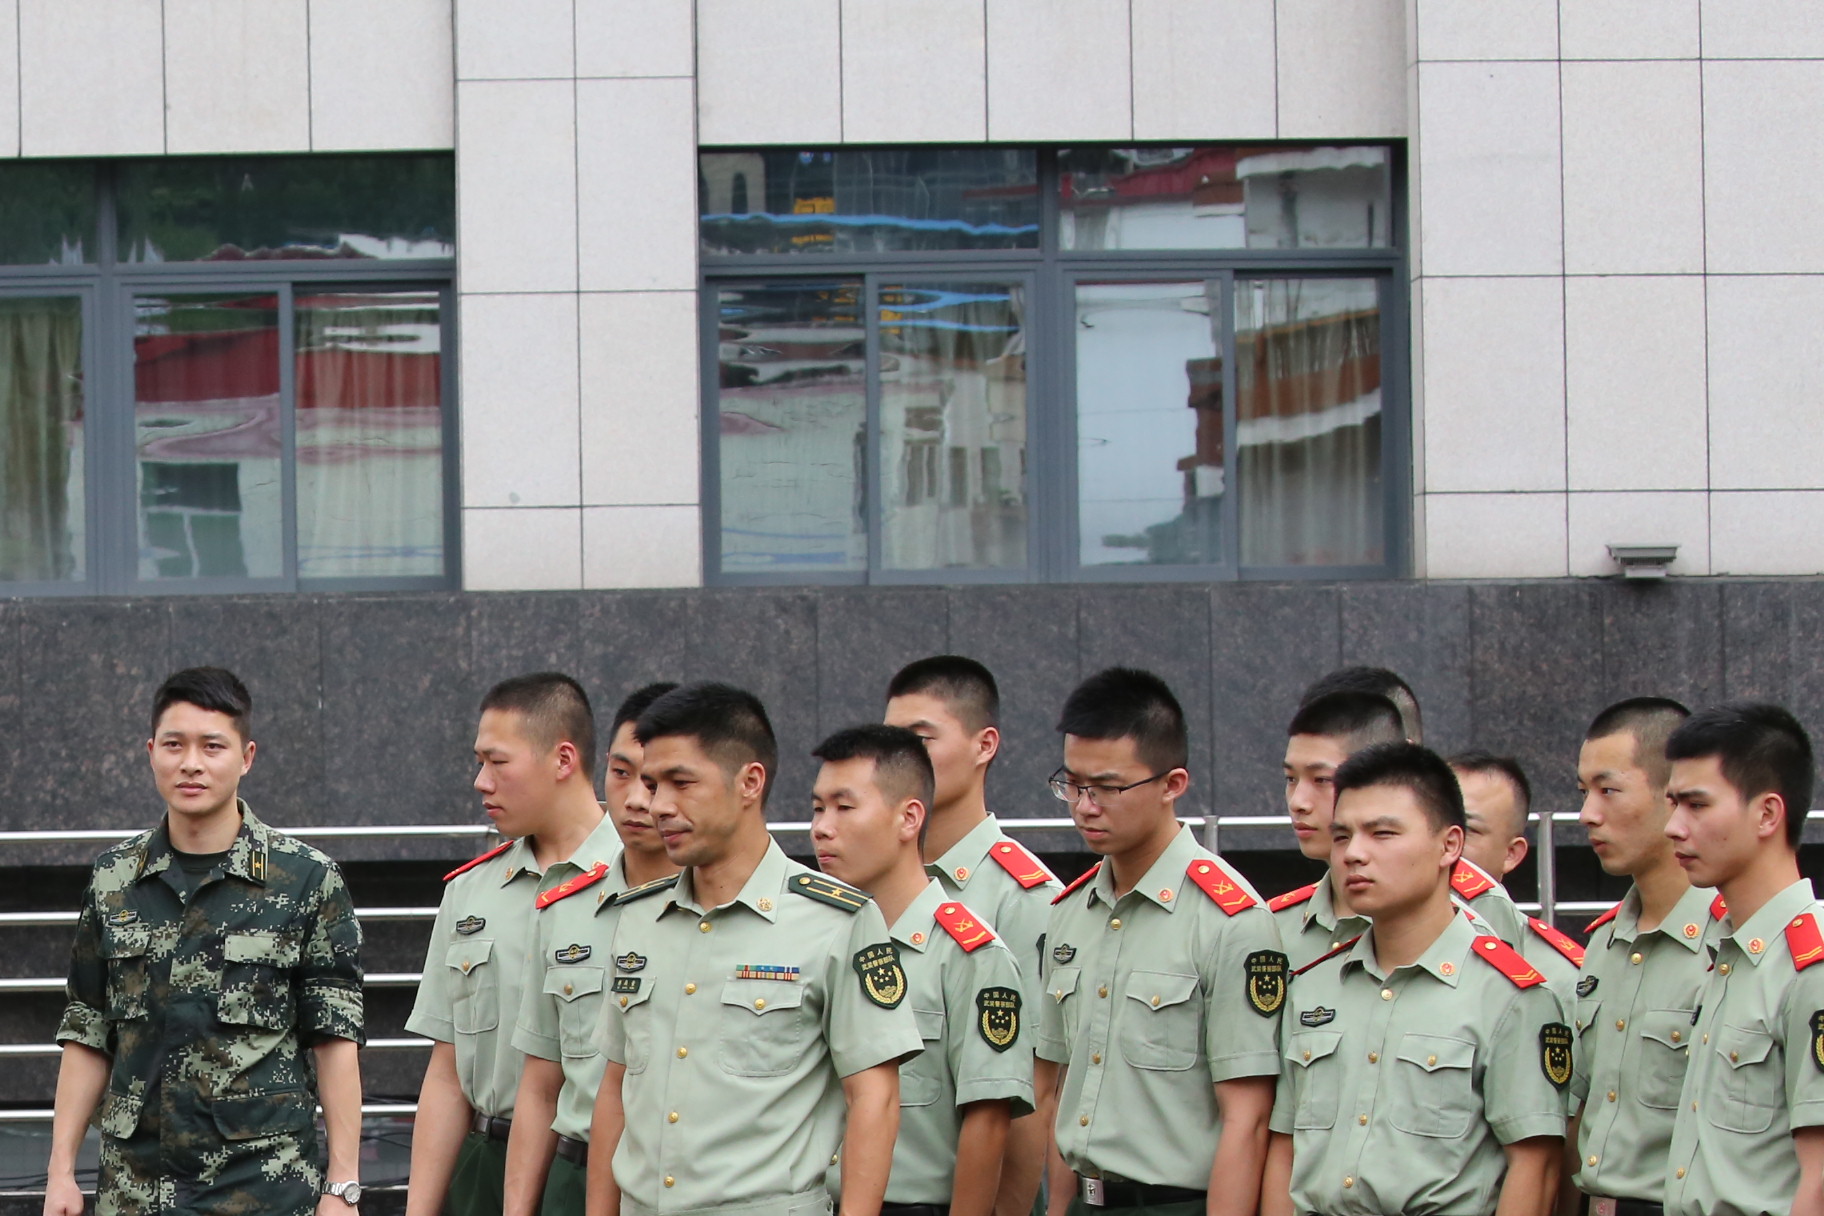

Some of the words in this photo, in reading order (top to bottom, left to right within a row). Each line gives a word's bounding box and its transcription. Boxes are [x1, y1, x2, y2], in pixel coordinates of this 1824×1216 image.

[858, 947, 893, 963] 中国人民
[1251, 955, 1283, 964] 中国人民
[861, 955, 895, 971] 武装警察部队
[983, 991, 1016, 1002] 中国人民
[983, 1000, 1016, 1008] 武装警察部队
